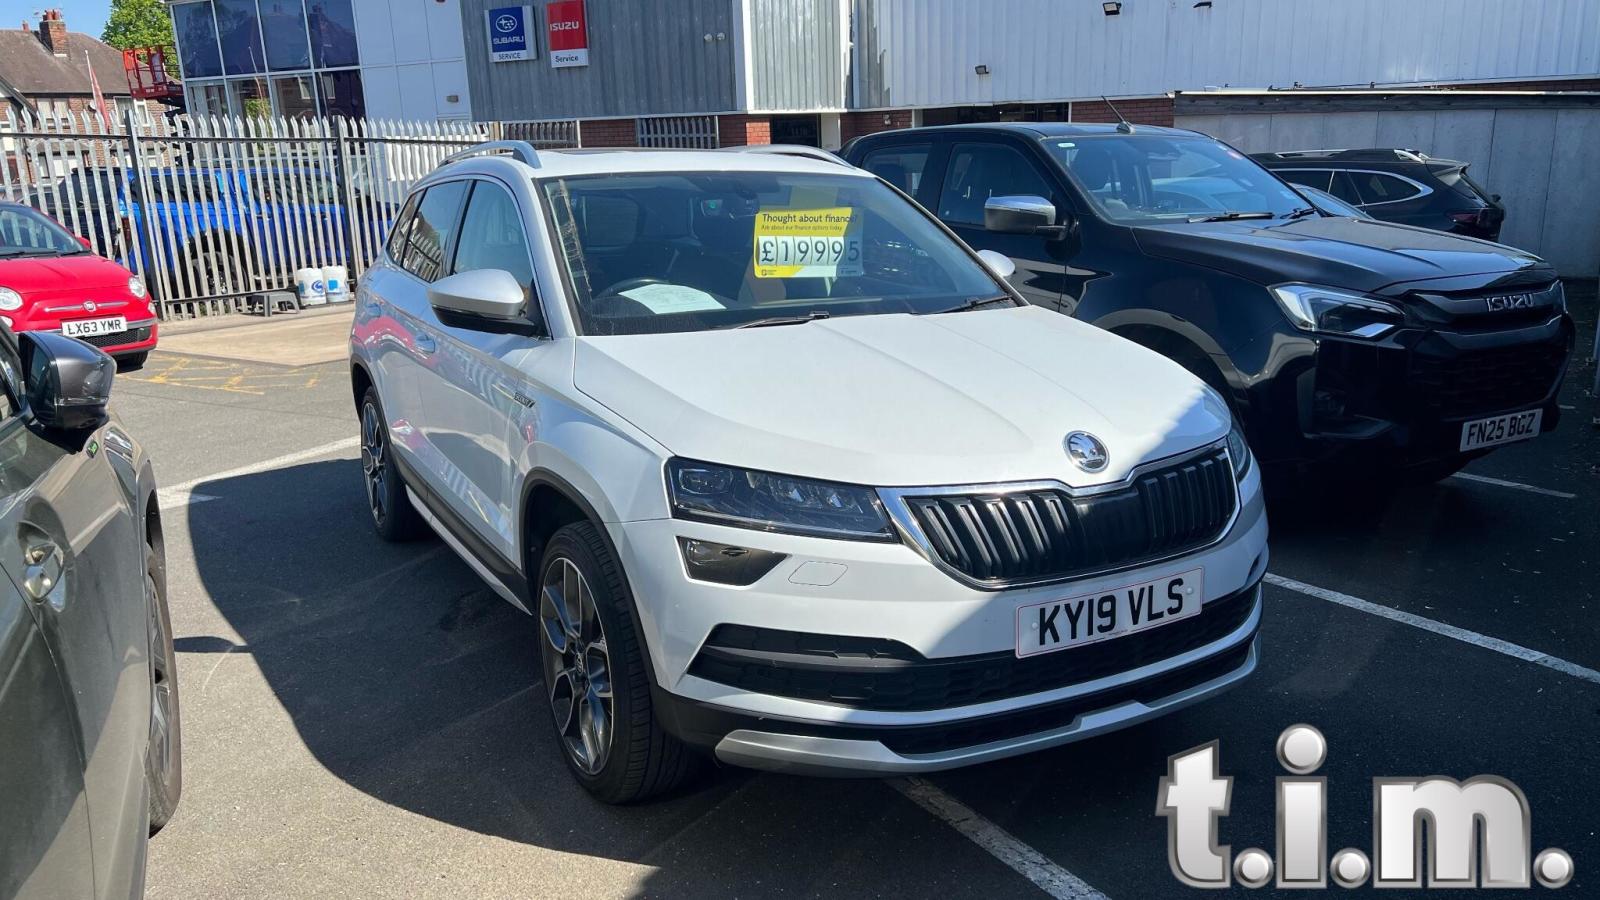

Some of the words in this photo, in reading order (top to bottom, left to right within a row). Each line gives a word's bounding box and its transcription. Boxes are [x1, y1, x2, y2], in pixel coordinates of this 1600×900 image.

[549, 21, 579, 31] ISUZU
[493, 36, 524, 44] SUBARU
[498, 52, 521, 60] SERVICE
[555, 54, 579, 63] Service
[763, 213, 797, 224] Thought
[799, 213, 823, 223] about
[761, 240, 860, 262] £19995
[1486, 293, 1535, 312] ISUZU
[67, 321, 98, 335] LX63
[100, 319, 122, 331] YMR
[1466, 419, 1504, 446] FN25
[1507, 413, 1536, 437] BGZ
[1038, 594, 1117, 646] KY19
[1127, 577, 1184, 626] VLS
